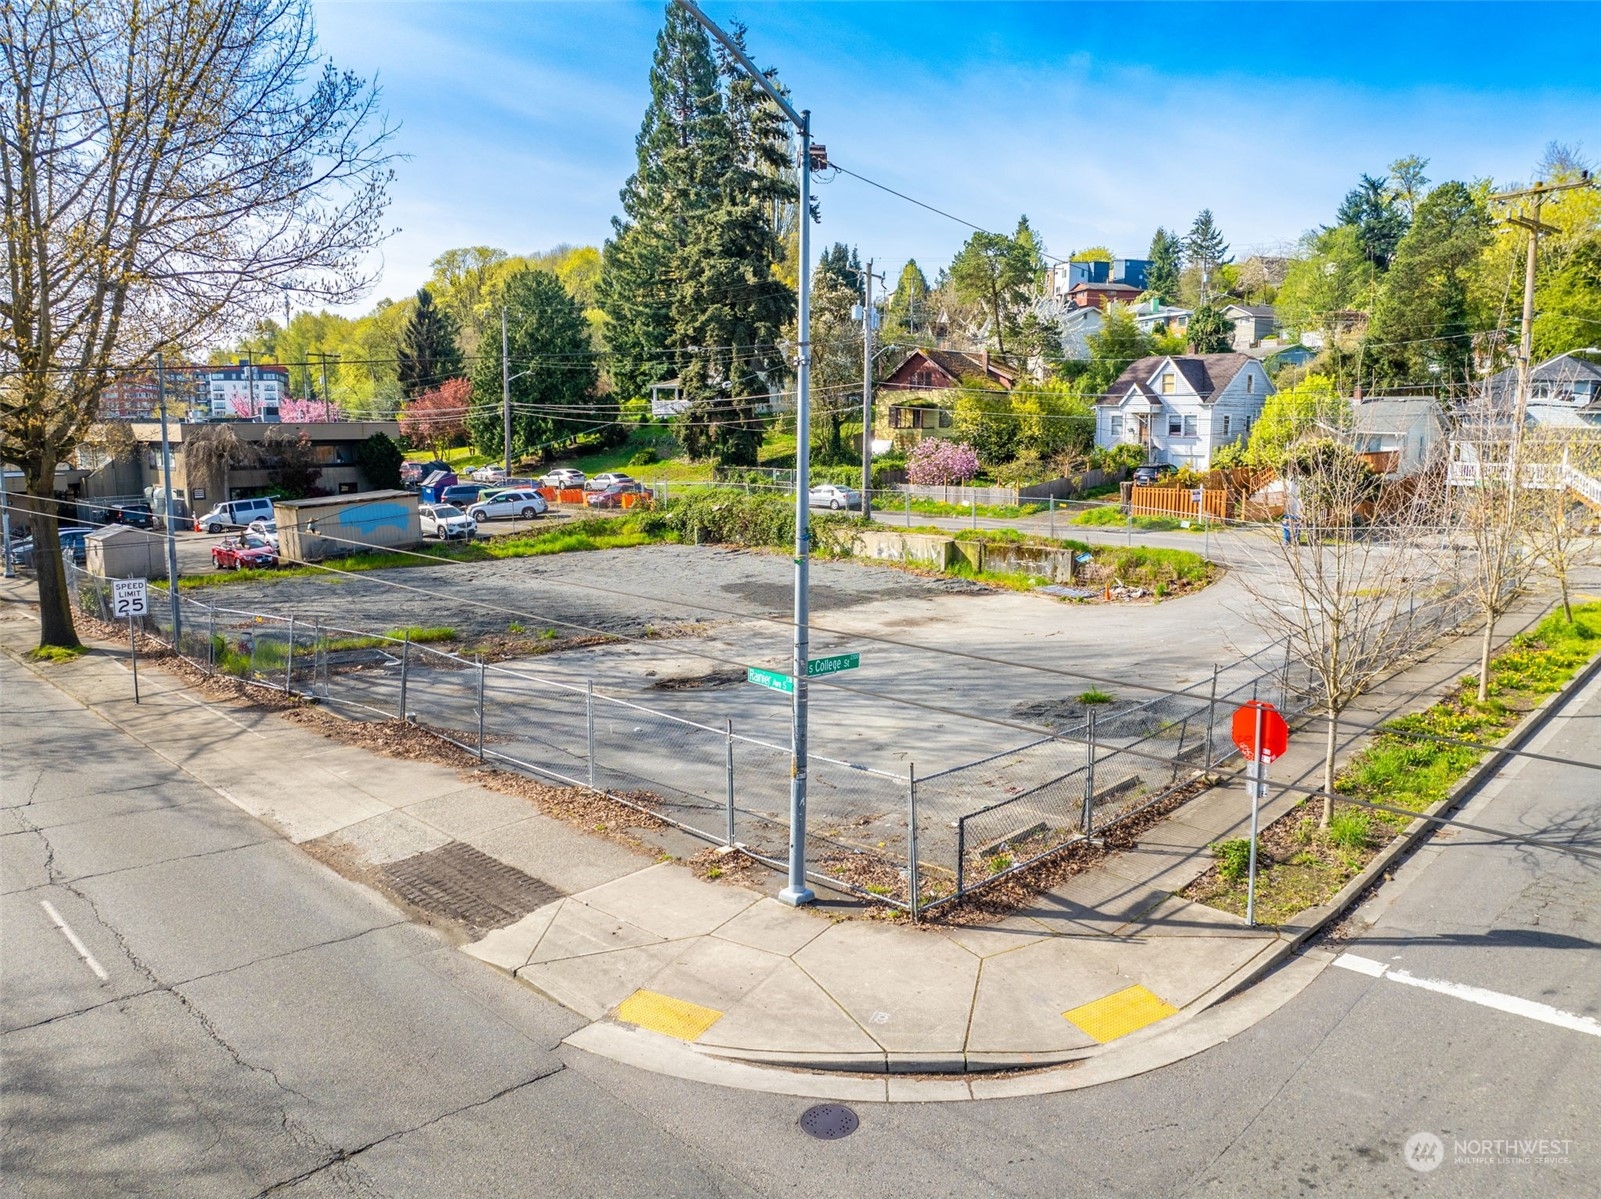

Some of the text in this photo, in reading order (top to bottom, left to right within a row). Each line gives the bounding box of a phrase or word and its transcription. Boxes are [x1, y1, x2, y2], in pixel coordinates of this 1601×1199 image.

[115, 582, 144, 591] SPEED
[118, 590, 141, 598] LIMIT
[118, 598, 144, 614] 25
[815, 658, 842, 673] College
